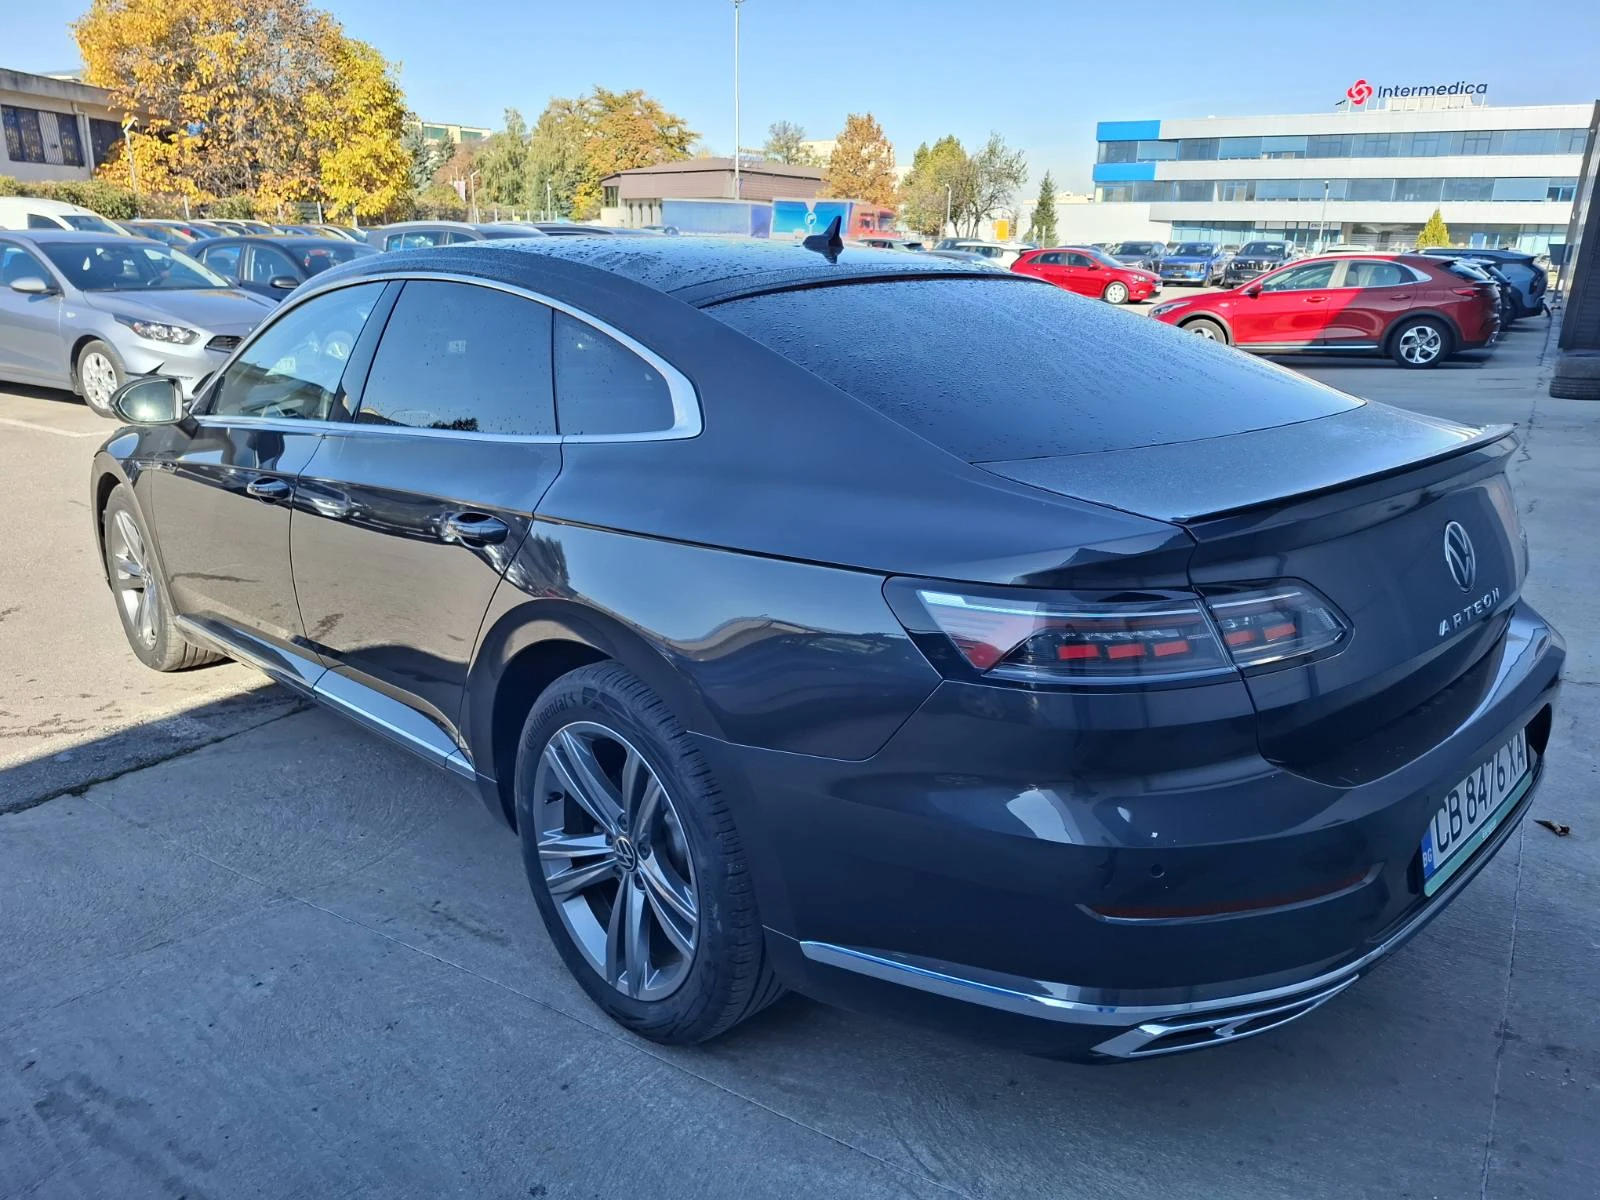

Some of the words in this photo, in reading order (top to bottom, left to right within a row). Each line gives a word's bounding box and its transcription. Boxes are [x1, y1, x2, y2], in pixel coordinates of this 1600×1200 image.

[1377, 80, 1488, 99] Intermedica
[1439, 587, 1501, 637] ARTEON
[1465, 751, 1506, 825] 8476
[1422, 850, 1433, 867] BG
